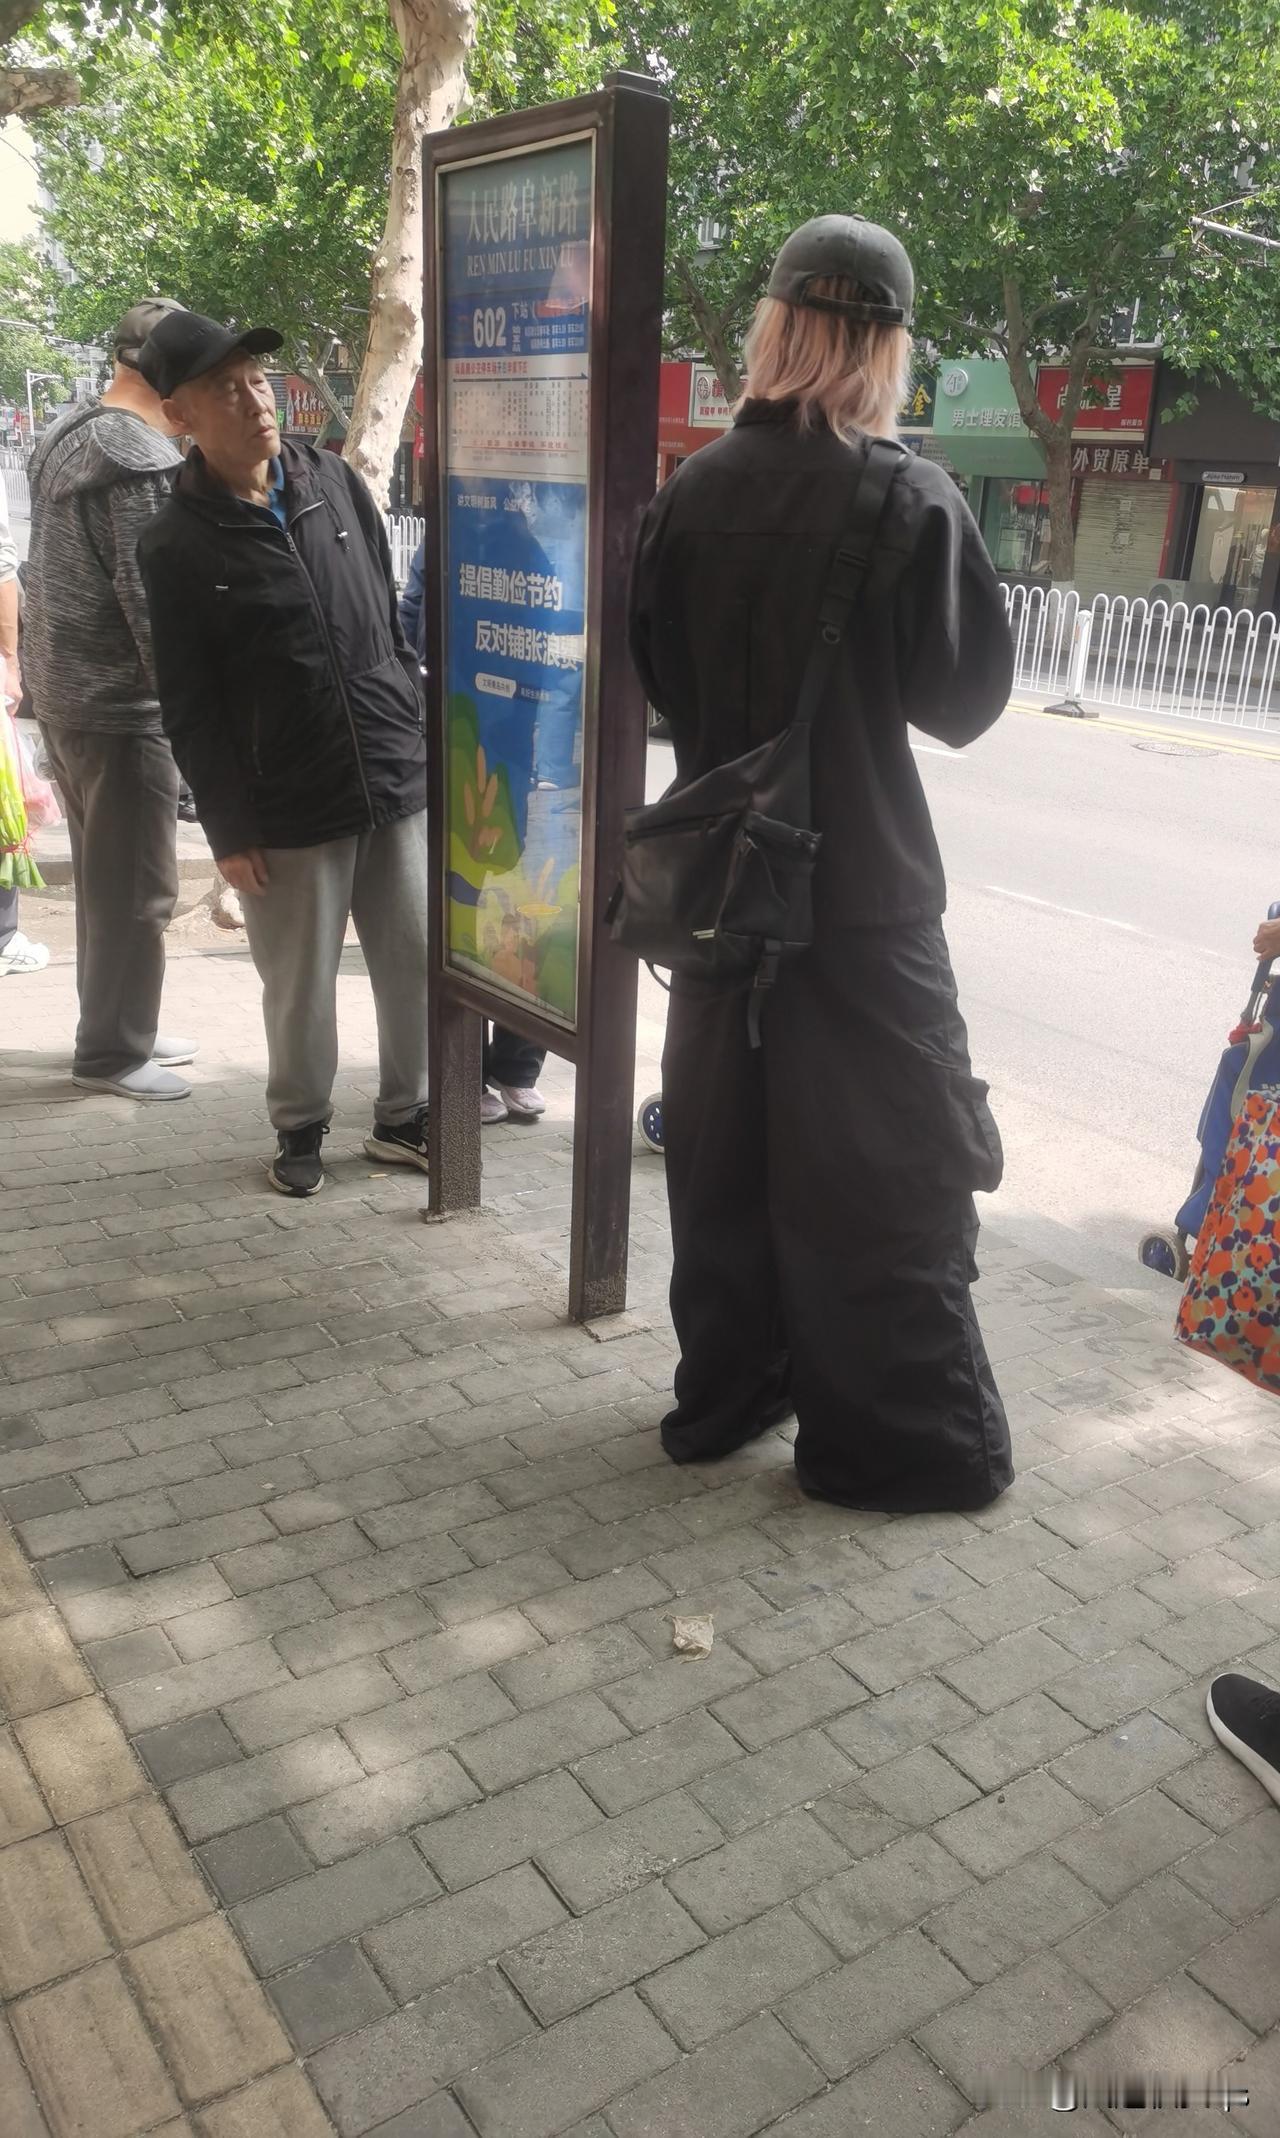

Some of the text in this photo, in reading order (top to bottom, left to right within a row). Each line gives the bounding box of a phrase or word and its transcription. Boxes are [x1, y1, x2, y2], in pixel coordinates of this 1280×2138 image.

[467, 171, 579, 244] 人民路阜新路
[467, 255, 485, 278] REN
[487, 252, 506, 275] MIN
[508, 250, 521, 273] LU
[523, 248, 535, 271] FU
[538, 246, 557, 270] XIN
[473, 306, 507, 348] 602
[952, 408, 1021, 429] 男士理发馆
[1072, 448, 1150, 474] 外贸原单
[459, 562, 563, 612] 提倡勤俭节约
[475, 619, 578, 672] 反对铺张浪费
